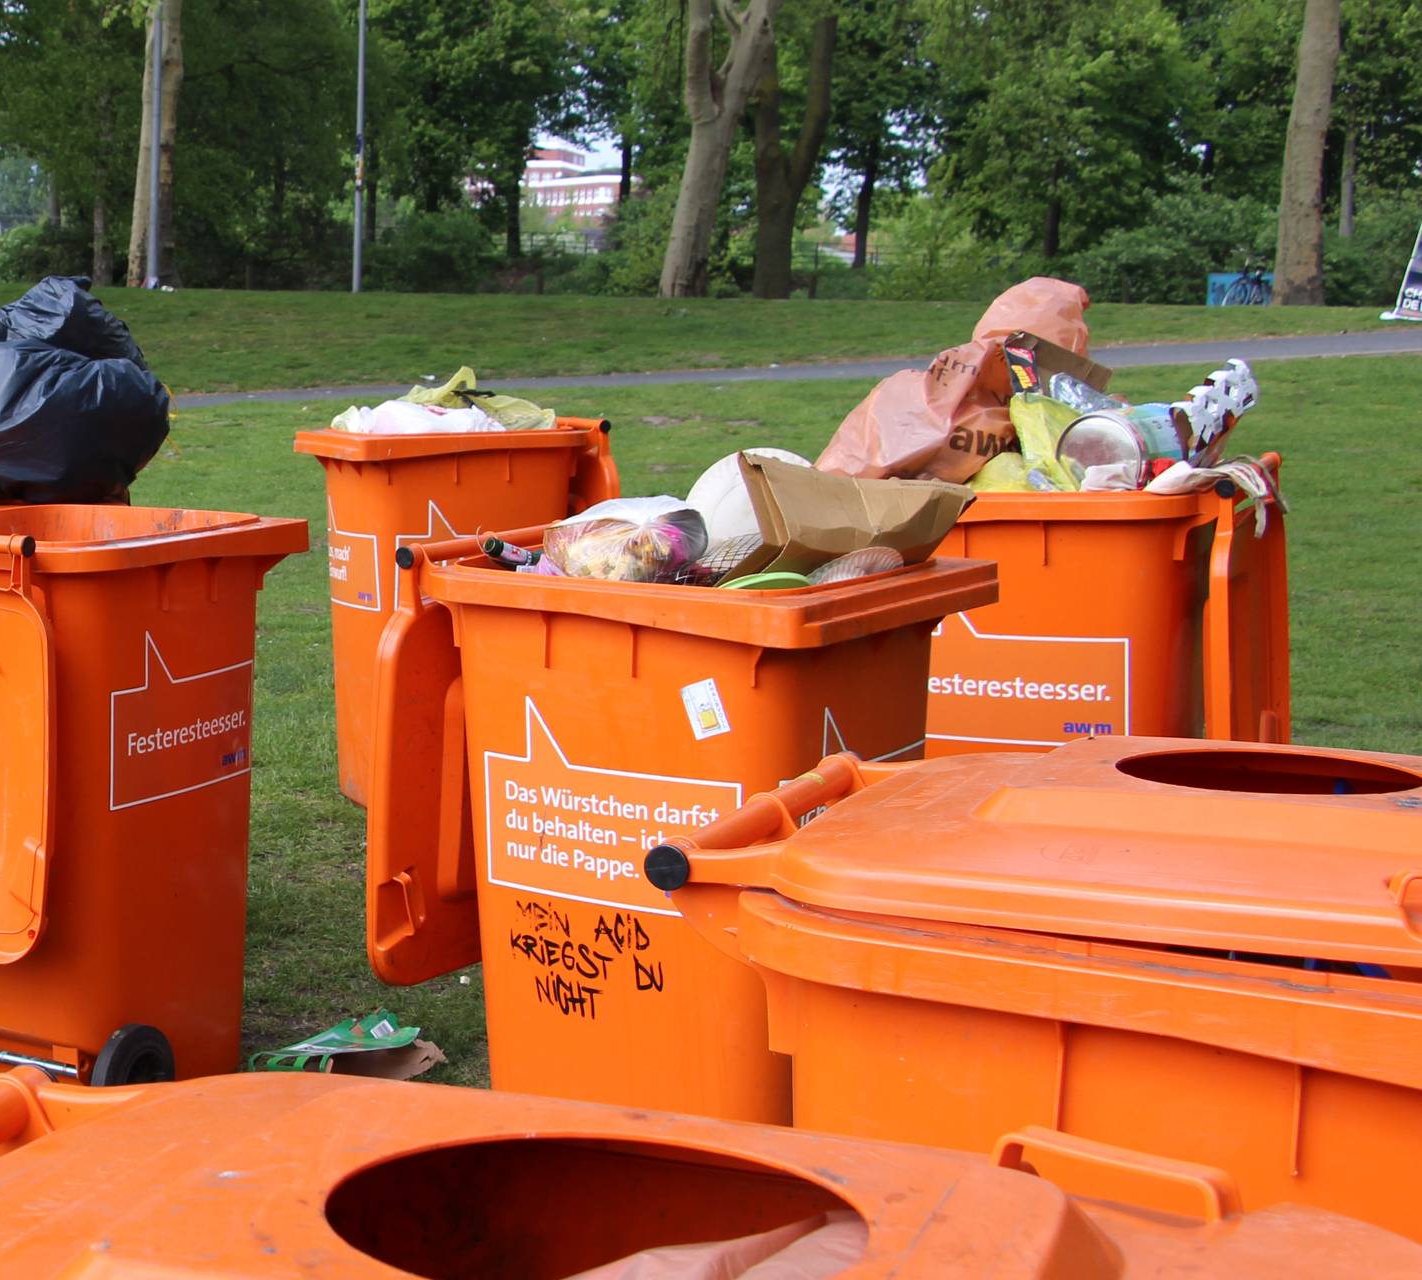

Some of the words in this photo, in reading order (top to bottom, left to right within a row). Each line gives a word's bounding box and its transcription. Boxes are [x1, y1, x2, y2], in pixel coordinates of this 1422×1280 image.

[927, 673, 1111, 702] esteresteesser.
[128, 710, 246, 757] Festeresteesser.
[505, 780, 538, 805] Das
[540, 785, 649, 821] Würstchen
[654, 801, 720, 828] darfst
[505, 808, 528, 831] du
[532, 812, 618, 846] behalten
[506, 841, 537, 861] nur
[540, 844, 570, 867] die
[573, 849, 640, 881] Pappe.
